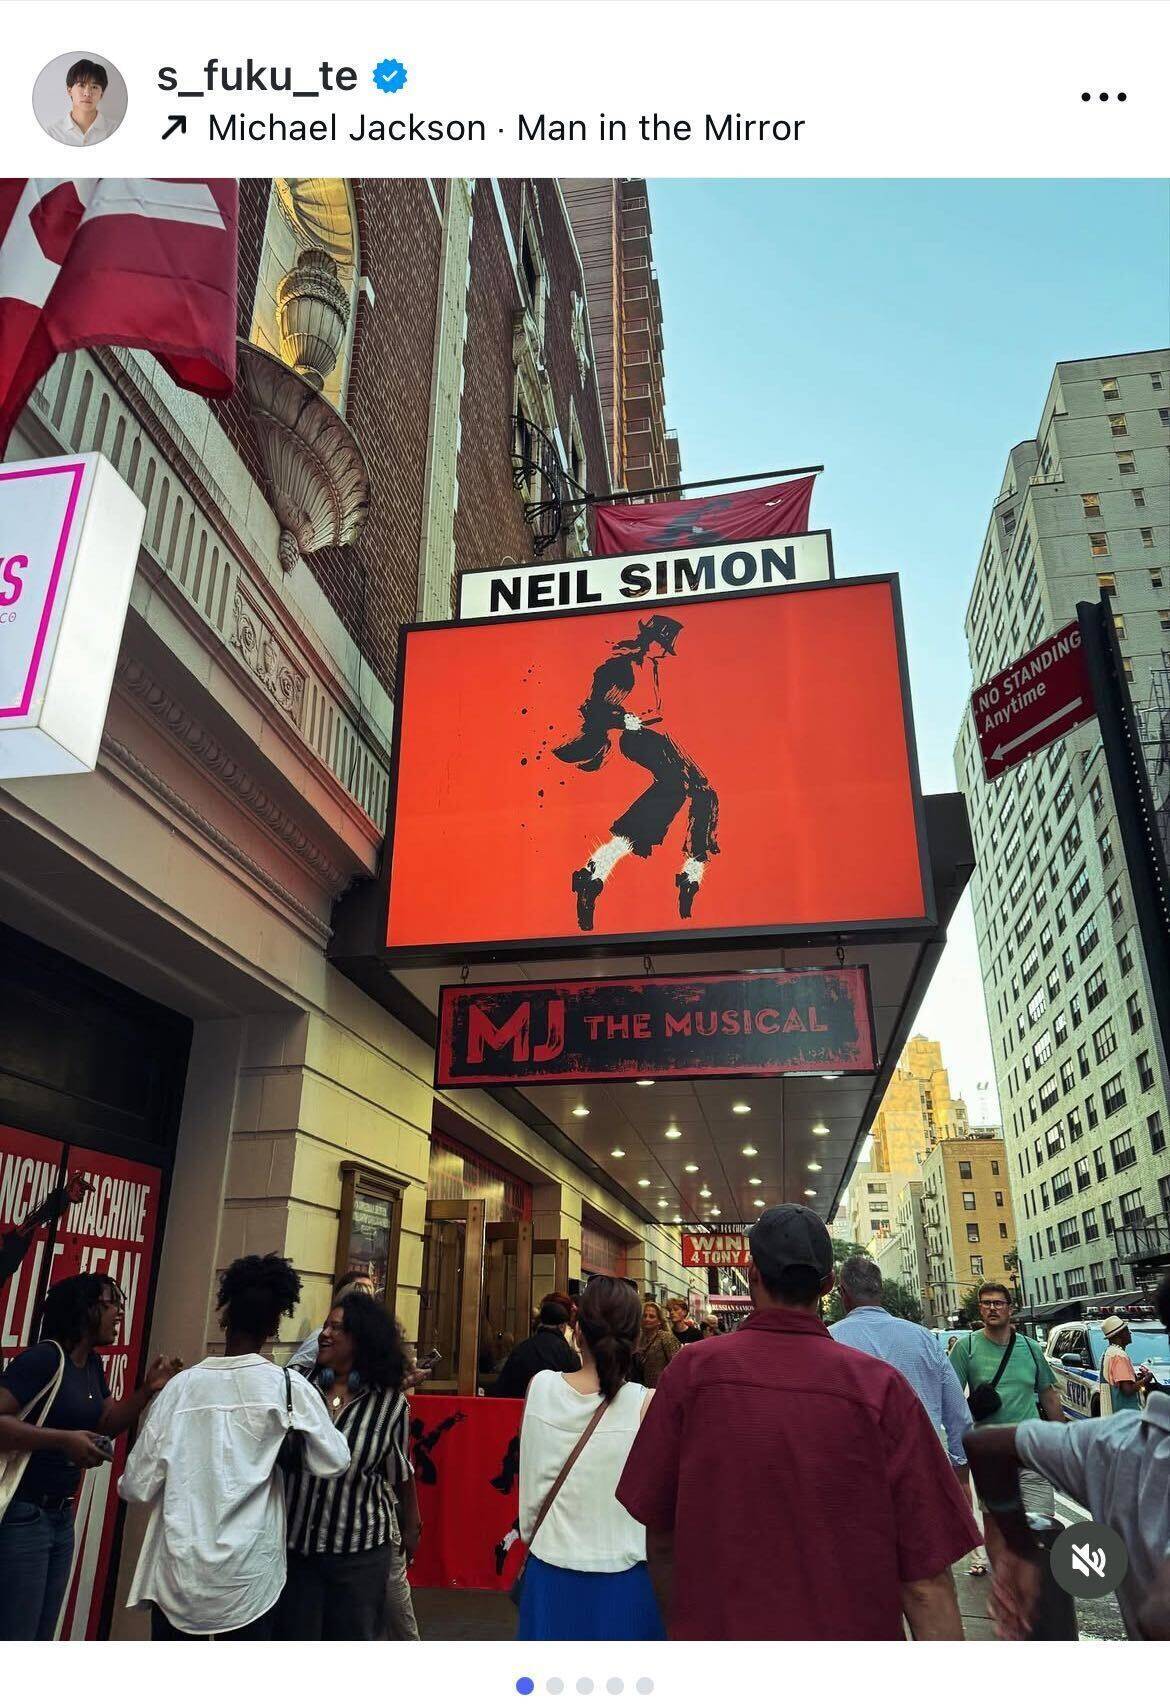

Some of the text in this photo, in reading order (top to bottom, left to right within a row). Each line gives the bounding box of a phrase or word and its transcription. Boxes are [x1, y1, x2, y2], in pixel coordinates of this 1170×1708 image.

[0, 555, 29, 606] S
[490, 545, 796, 612] NEIL SIMON
[978, 630, 1082, 713] NO STANDING
[984, 682, 1047, 733] Anytime
[466, 1000, 829, 1063] MJ THE MUSICAL
[691, 1252, 700, 1263] 4
[702, 1251, 740, 1264] TONY
